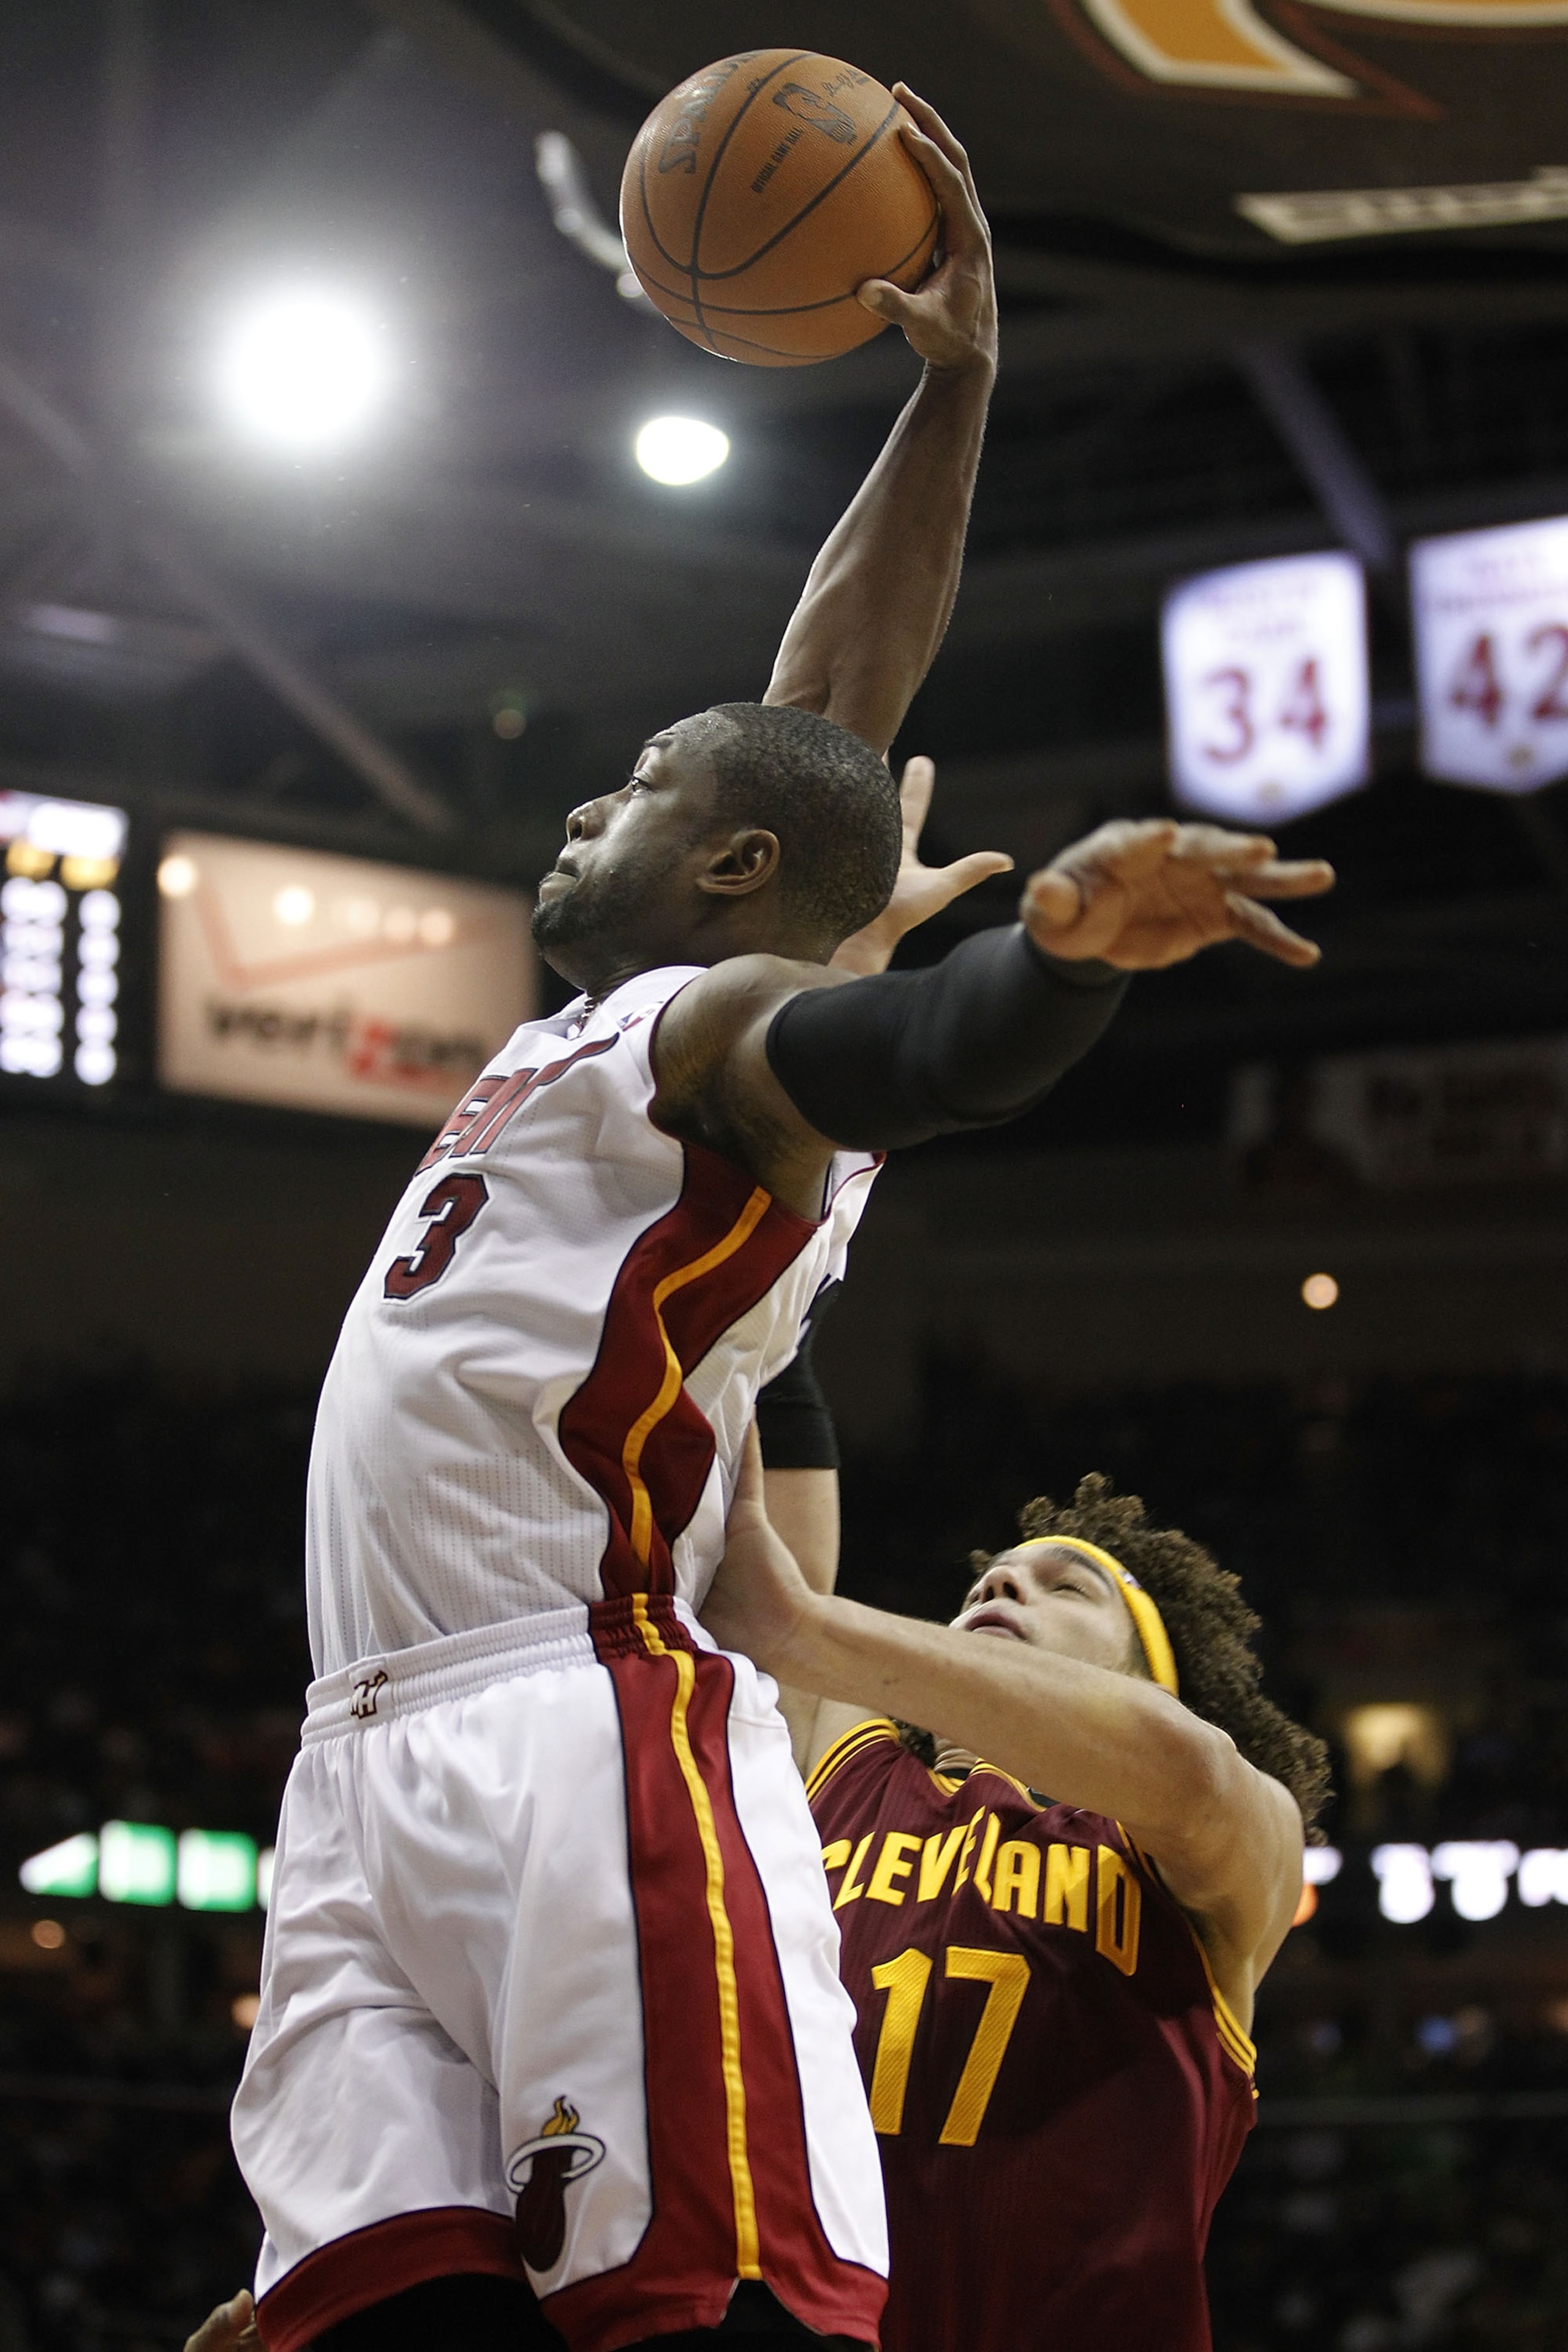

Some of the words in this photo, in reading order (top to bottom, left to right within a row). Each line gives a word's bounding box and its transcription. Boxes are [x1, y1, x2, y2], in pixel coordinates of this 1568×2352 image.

[658, 51, 755, 174] SPALD
[1197, 657, 1329, 768] 34
[1448, 624, 1568, 730] 42
[383, 1171, 490, 1300] 3
[869, 1945, 1031, 2147] 17
